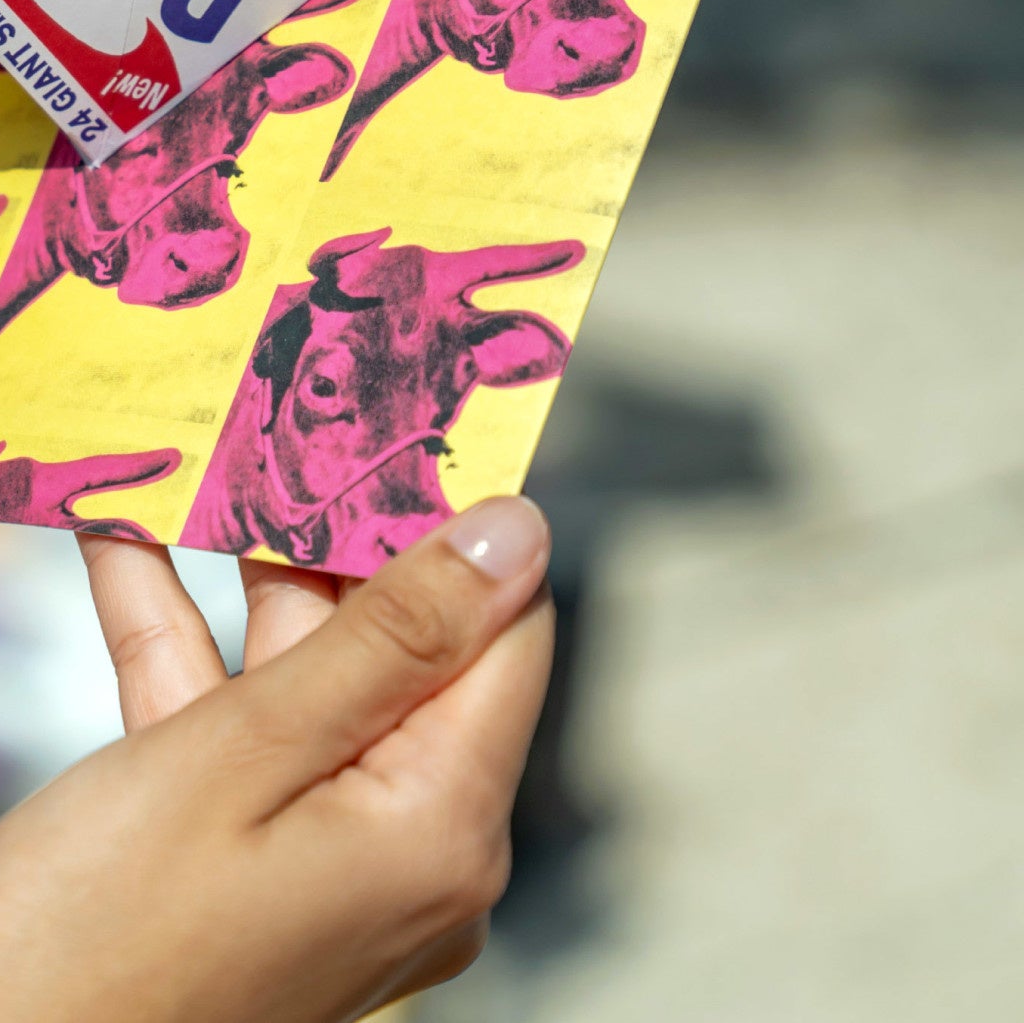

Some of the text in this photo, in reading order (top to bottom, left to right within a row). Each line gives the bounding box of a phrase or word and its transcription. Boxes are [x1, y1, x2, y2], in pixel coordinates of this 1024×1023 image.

[3, 43, 77, 112] GIANT
[101, 69, 170, 111] New!
[68, 108, 109, 142] 24
